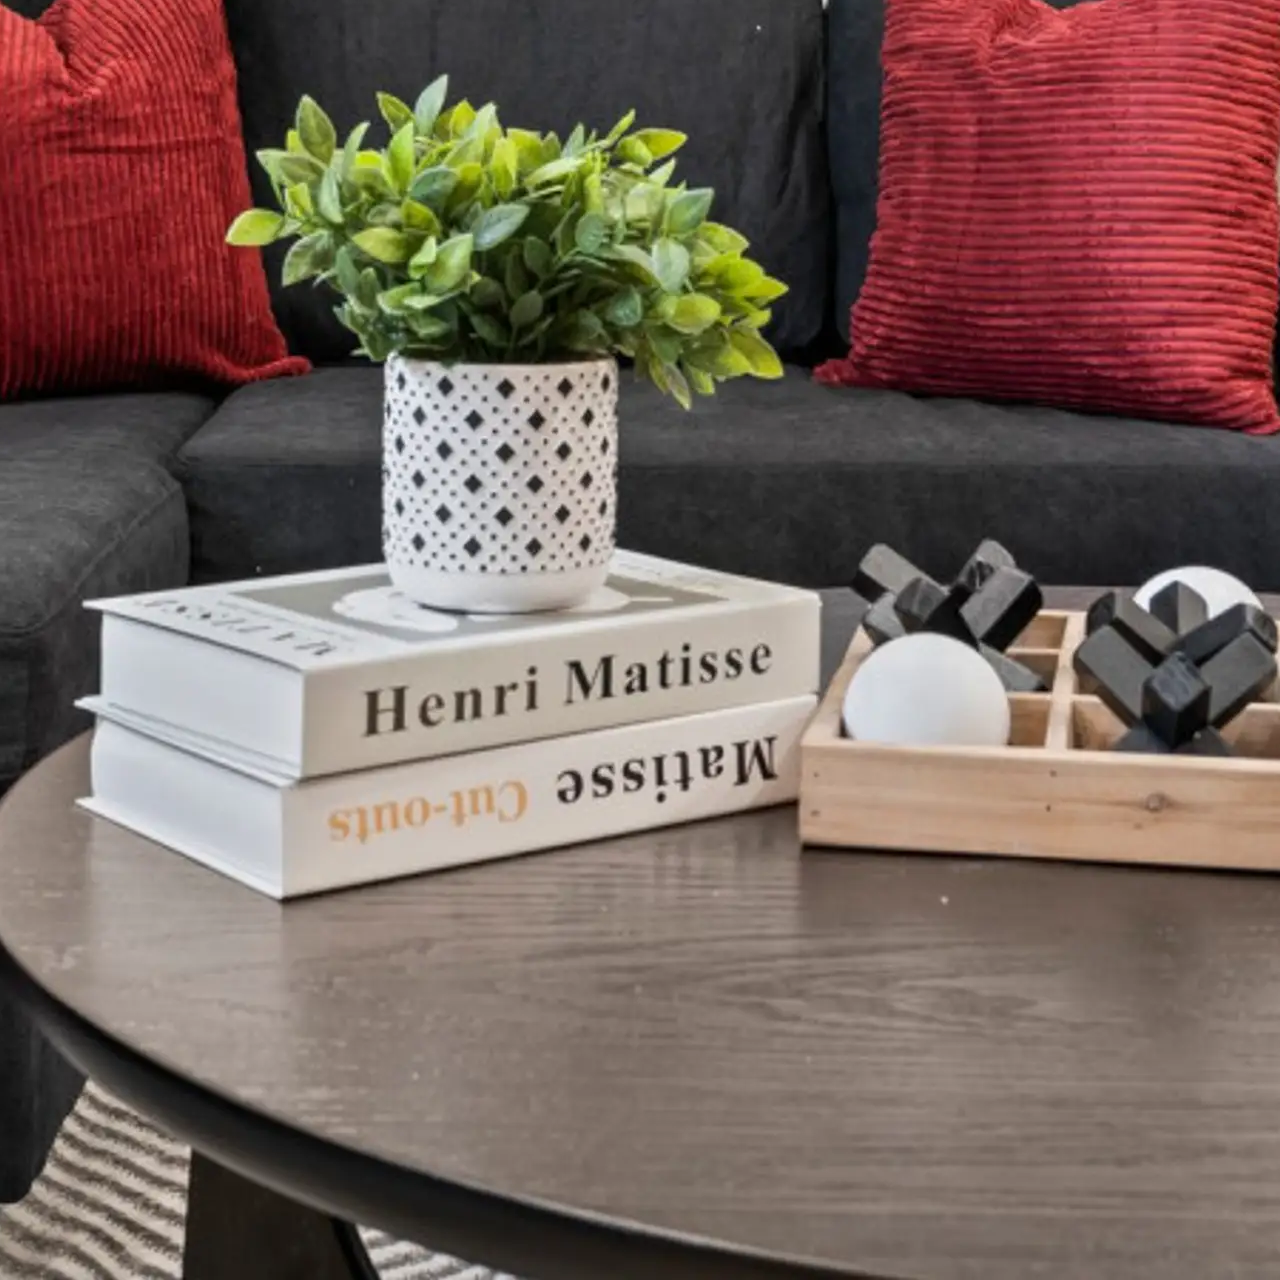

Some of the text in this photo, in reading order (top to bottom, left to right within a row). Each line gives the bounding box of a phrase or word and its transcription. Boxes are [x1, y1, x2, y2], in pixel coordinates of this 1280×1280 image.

[362, 642, 774, 738] Henri Matisse
[327, 735, 779, 845] Matisse Cut-outs
